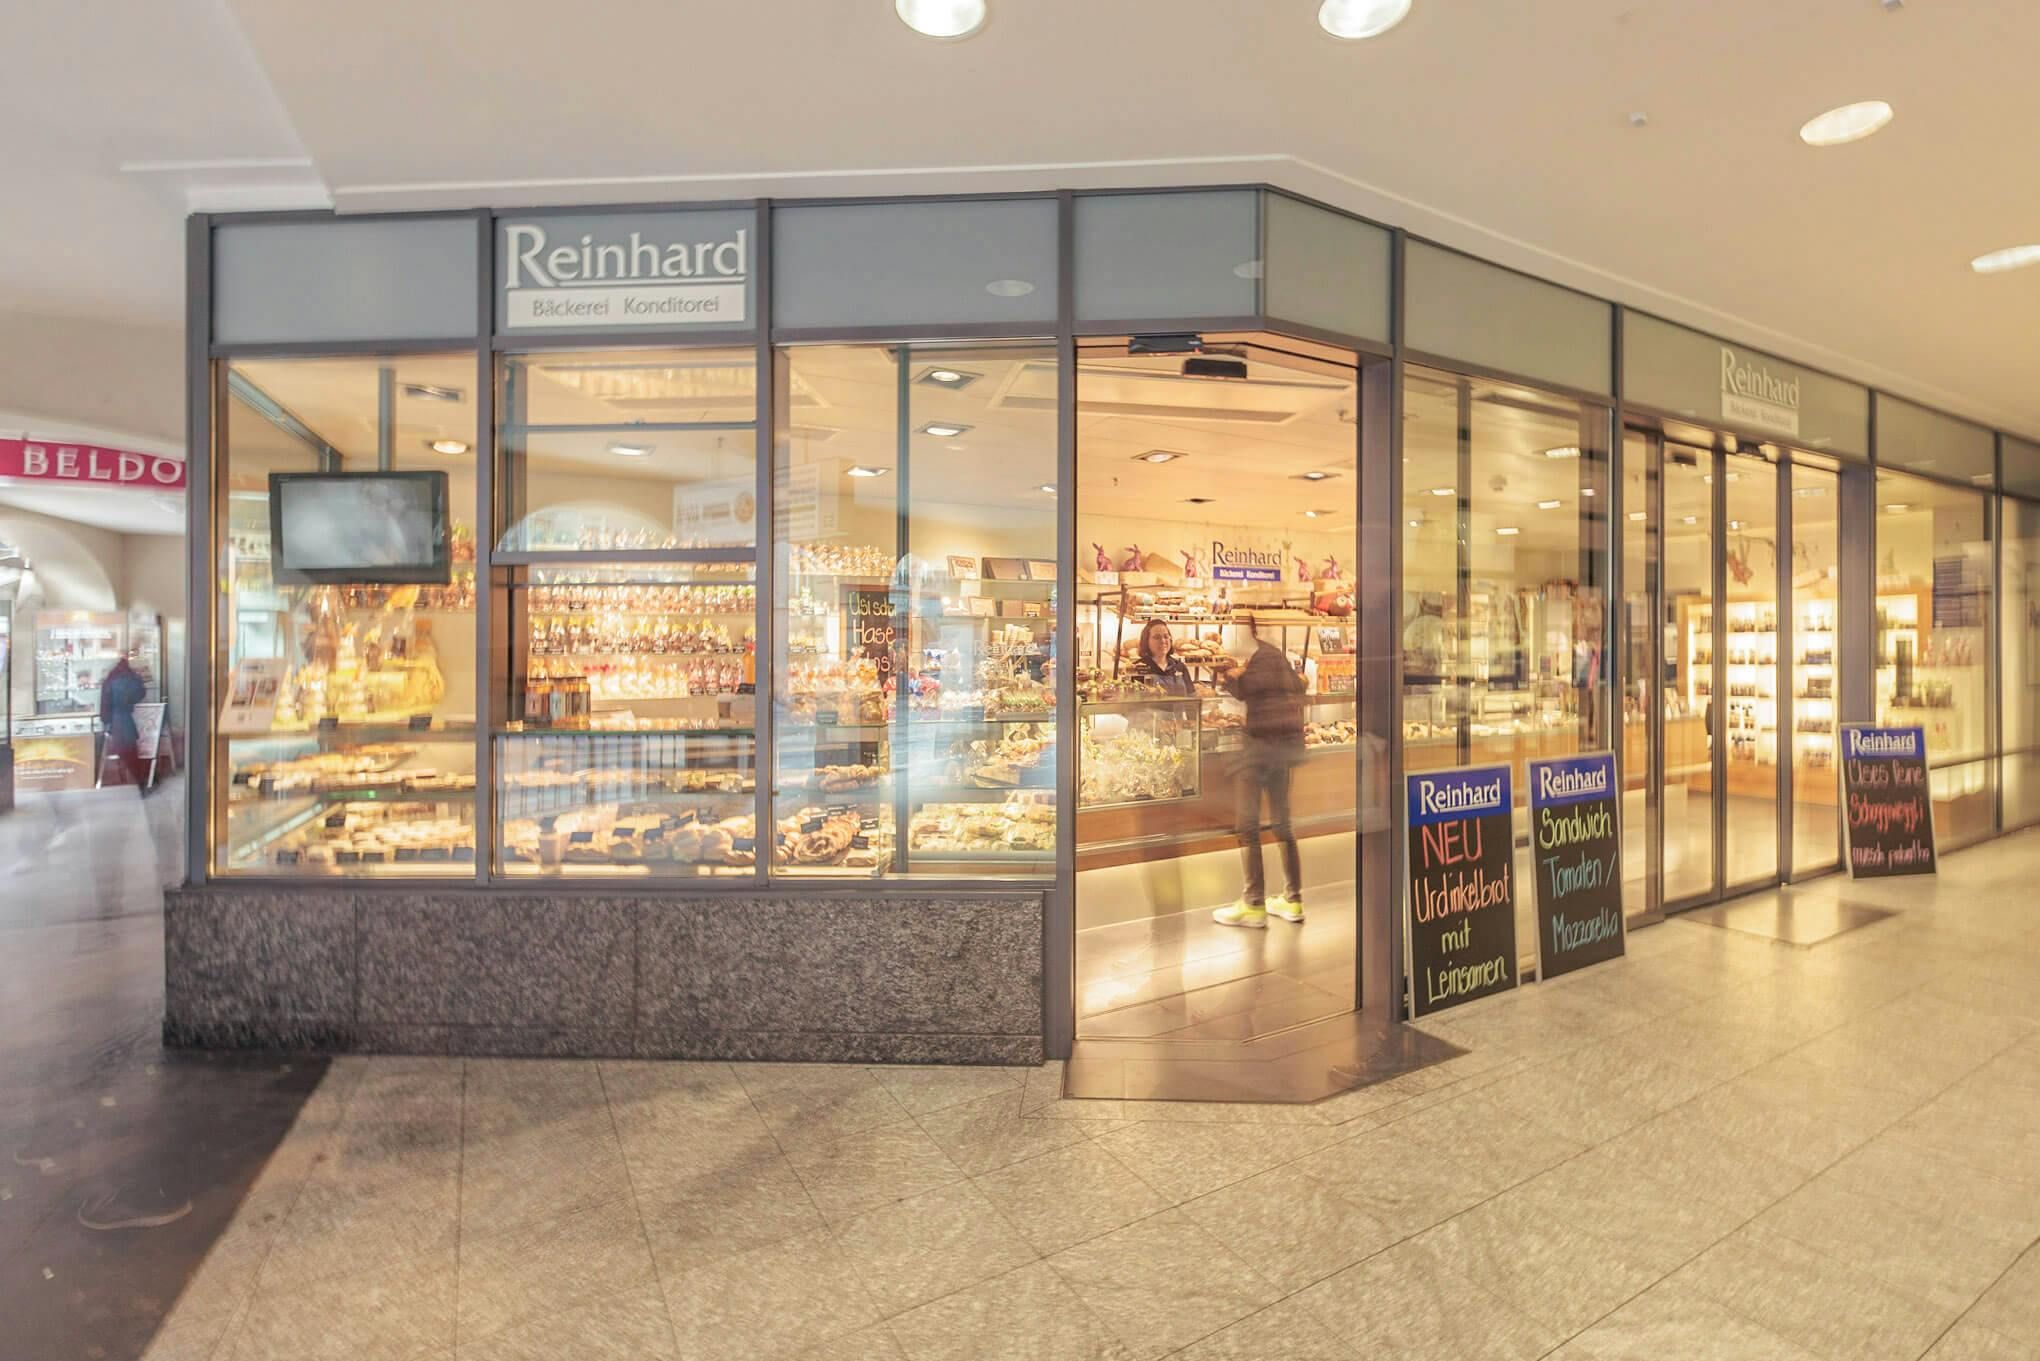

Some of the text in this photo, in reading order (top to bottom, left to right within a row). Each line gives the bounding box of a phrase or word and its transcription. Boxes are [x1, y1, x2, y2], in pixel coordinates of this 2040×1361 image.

[505, 224, 748, 288] Reinhard
[532, 296, 719, 318] Bäckerei Konditorei
[1720, 347, 1800, 407] Reinhard
[23, 444, 183, 484] BELDO
[1212, 541, 1282, 565] Reinhard
[1850, 729, 1916, 755] Reinhard
[1420, 778, 1501, 815] Reinhard
[1540, 765, 1607, 800] Reinhard
[1421, 817, 1483, 868] NEU
[1539, 801, 1613, 849] Sandwich
[1414, 863, 1510, 923] Urdinkelbrot
[1543, 853, 1602, 899] Tomaten
[1441, 917, 1472, 954] mit
[1552, 908, 1619, 954] Mozzarella
[1427, 954, 1509, 1004] Leinsamen
